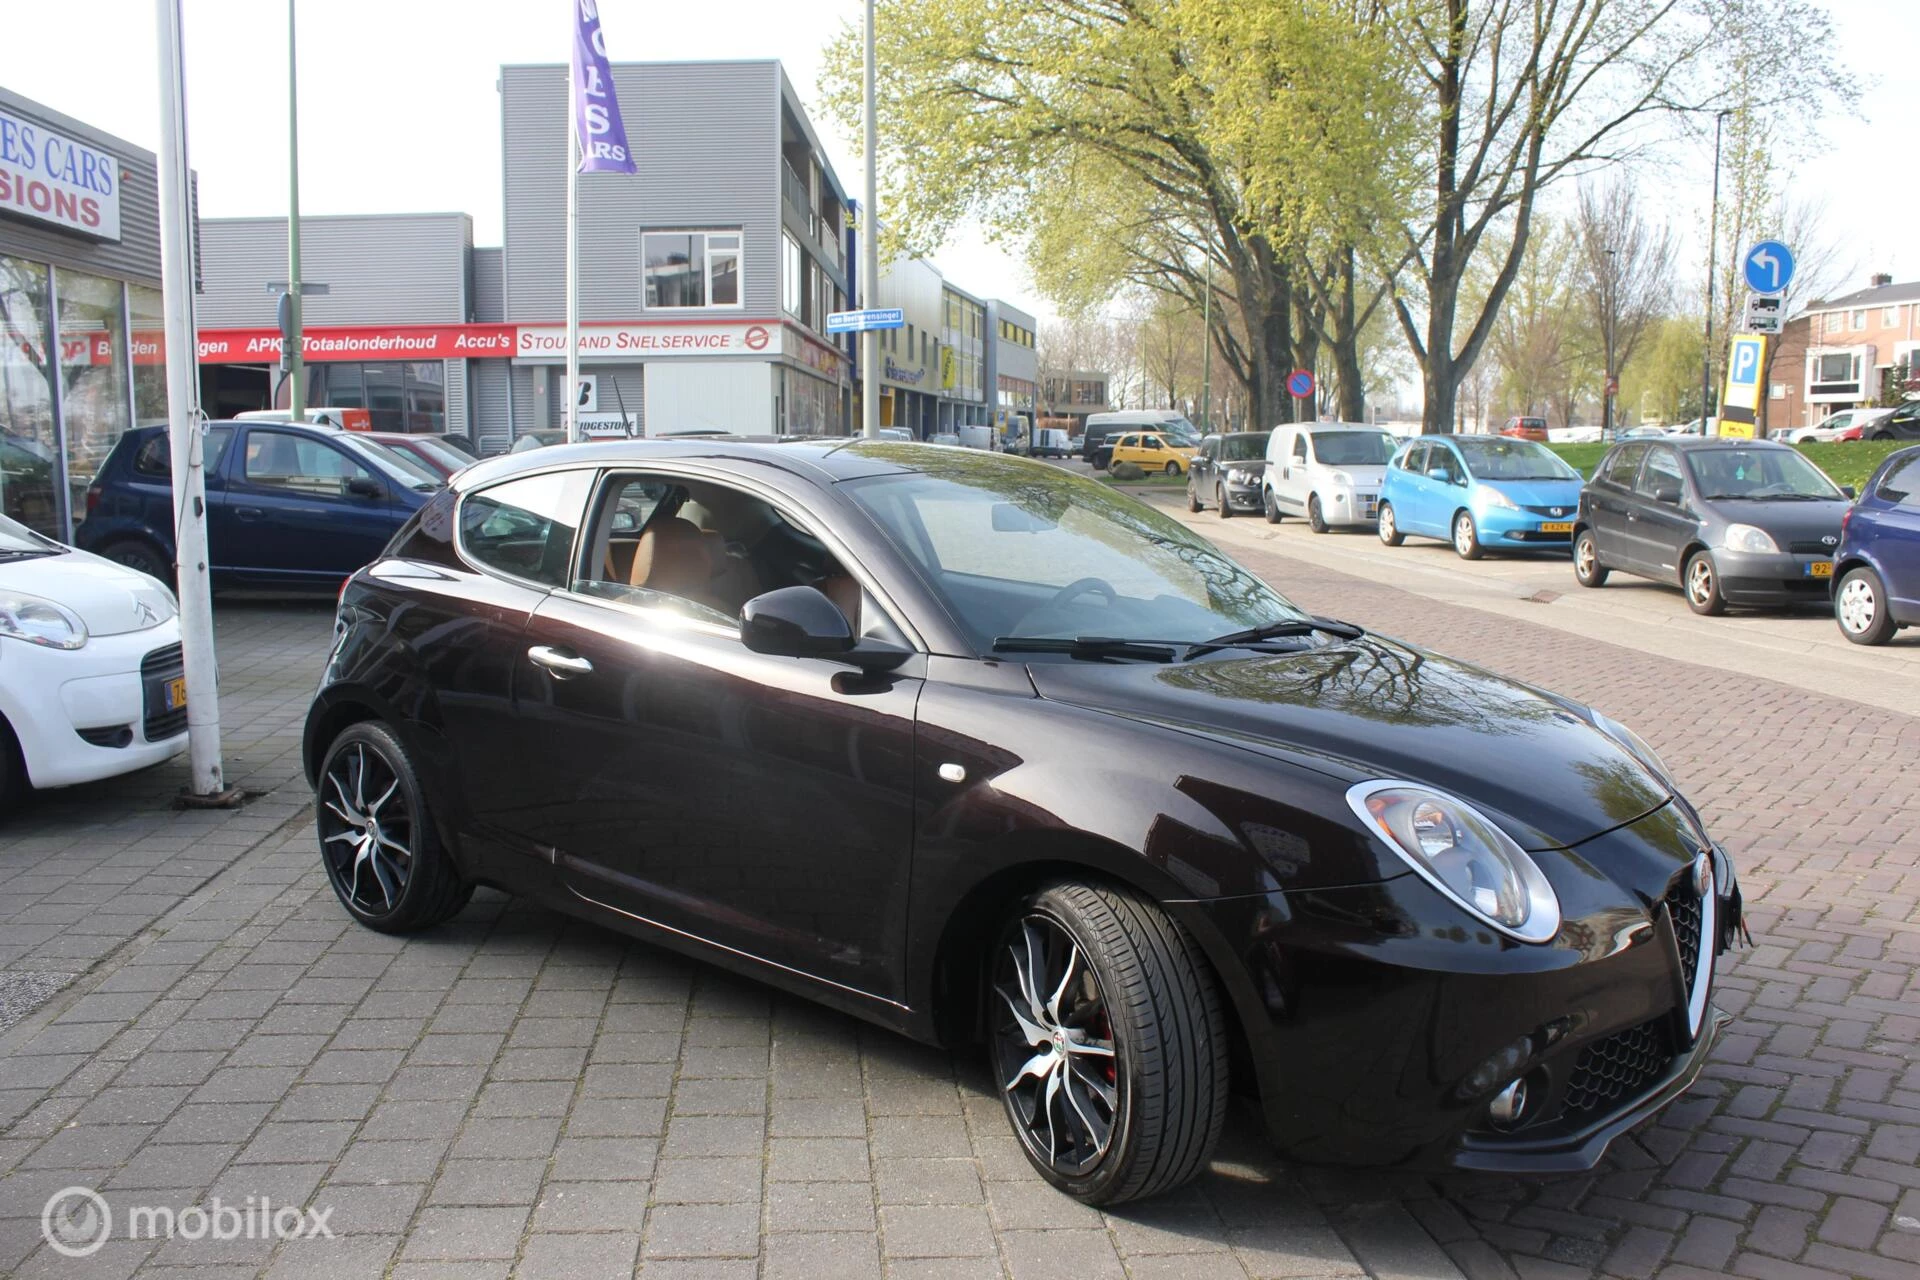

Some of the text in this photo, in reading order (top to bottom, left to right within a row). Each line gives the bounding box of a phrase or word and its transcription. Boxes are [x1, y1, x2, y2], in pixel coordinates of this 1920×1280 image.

[44, 136, 112, 196] CARS
[246, 337, 283, 352] APK
[302, 335, 437, 352] Totaalonderhoud
[455, 333, 510, 348] Accu's
[520, 332, 731, 350] STOUAND SNELSERVICE
[1736, 345, 1754, 380] P
